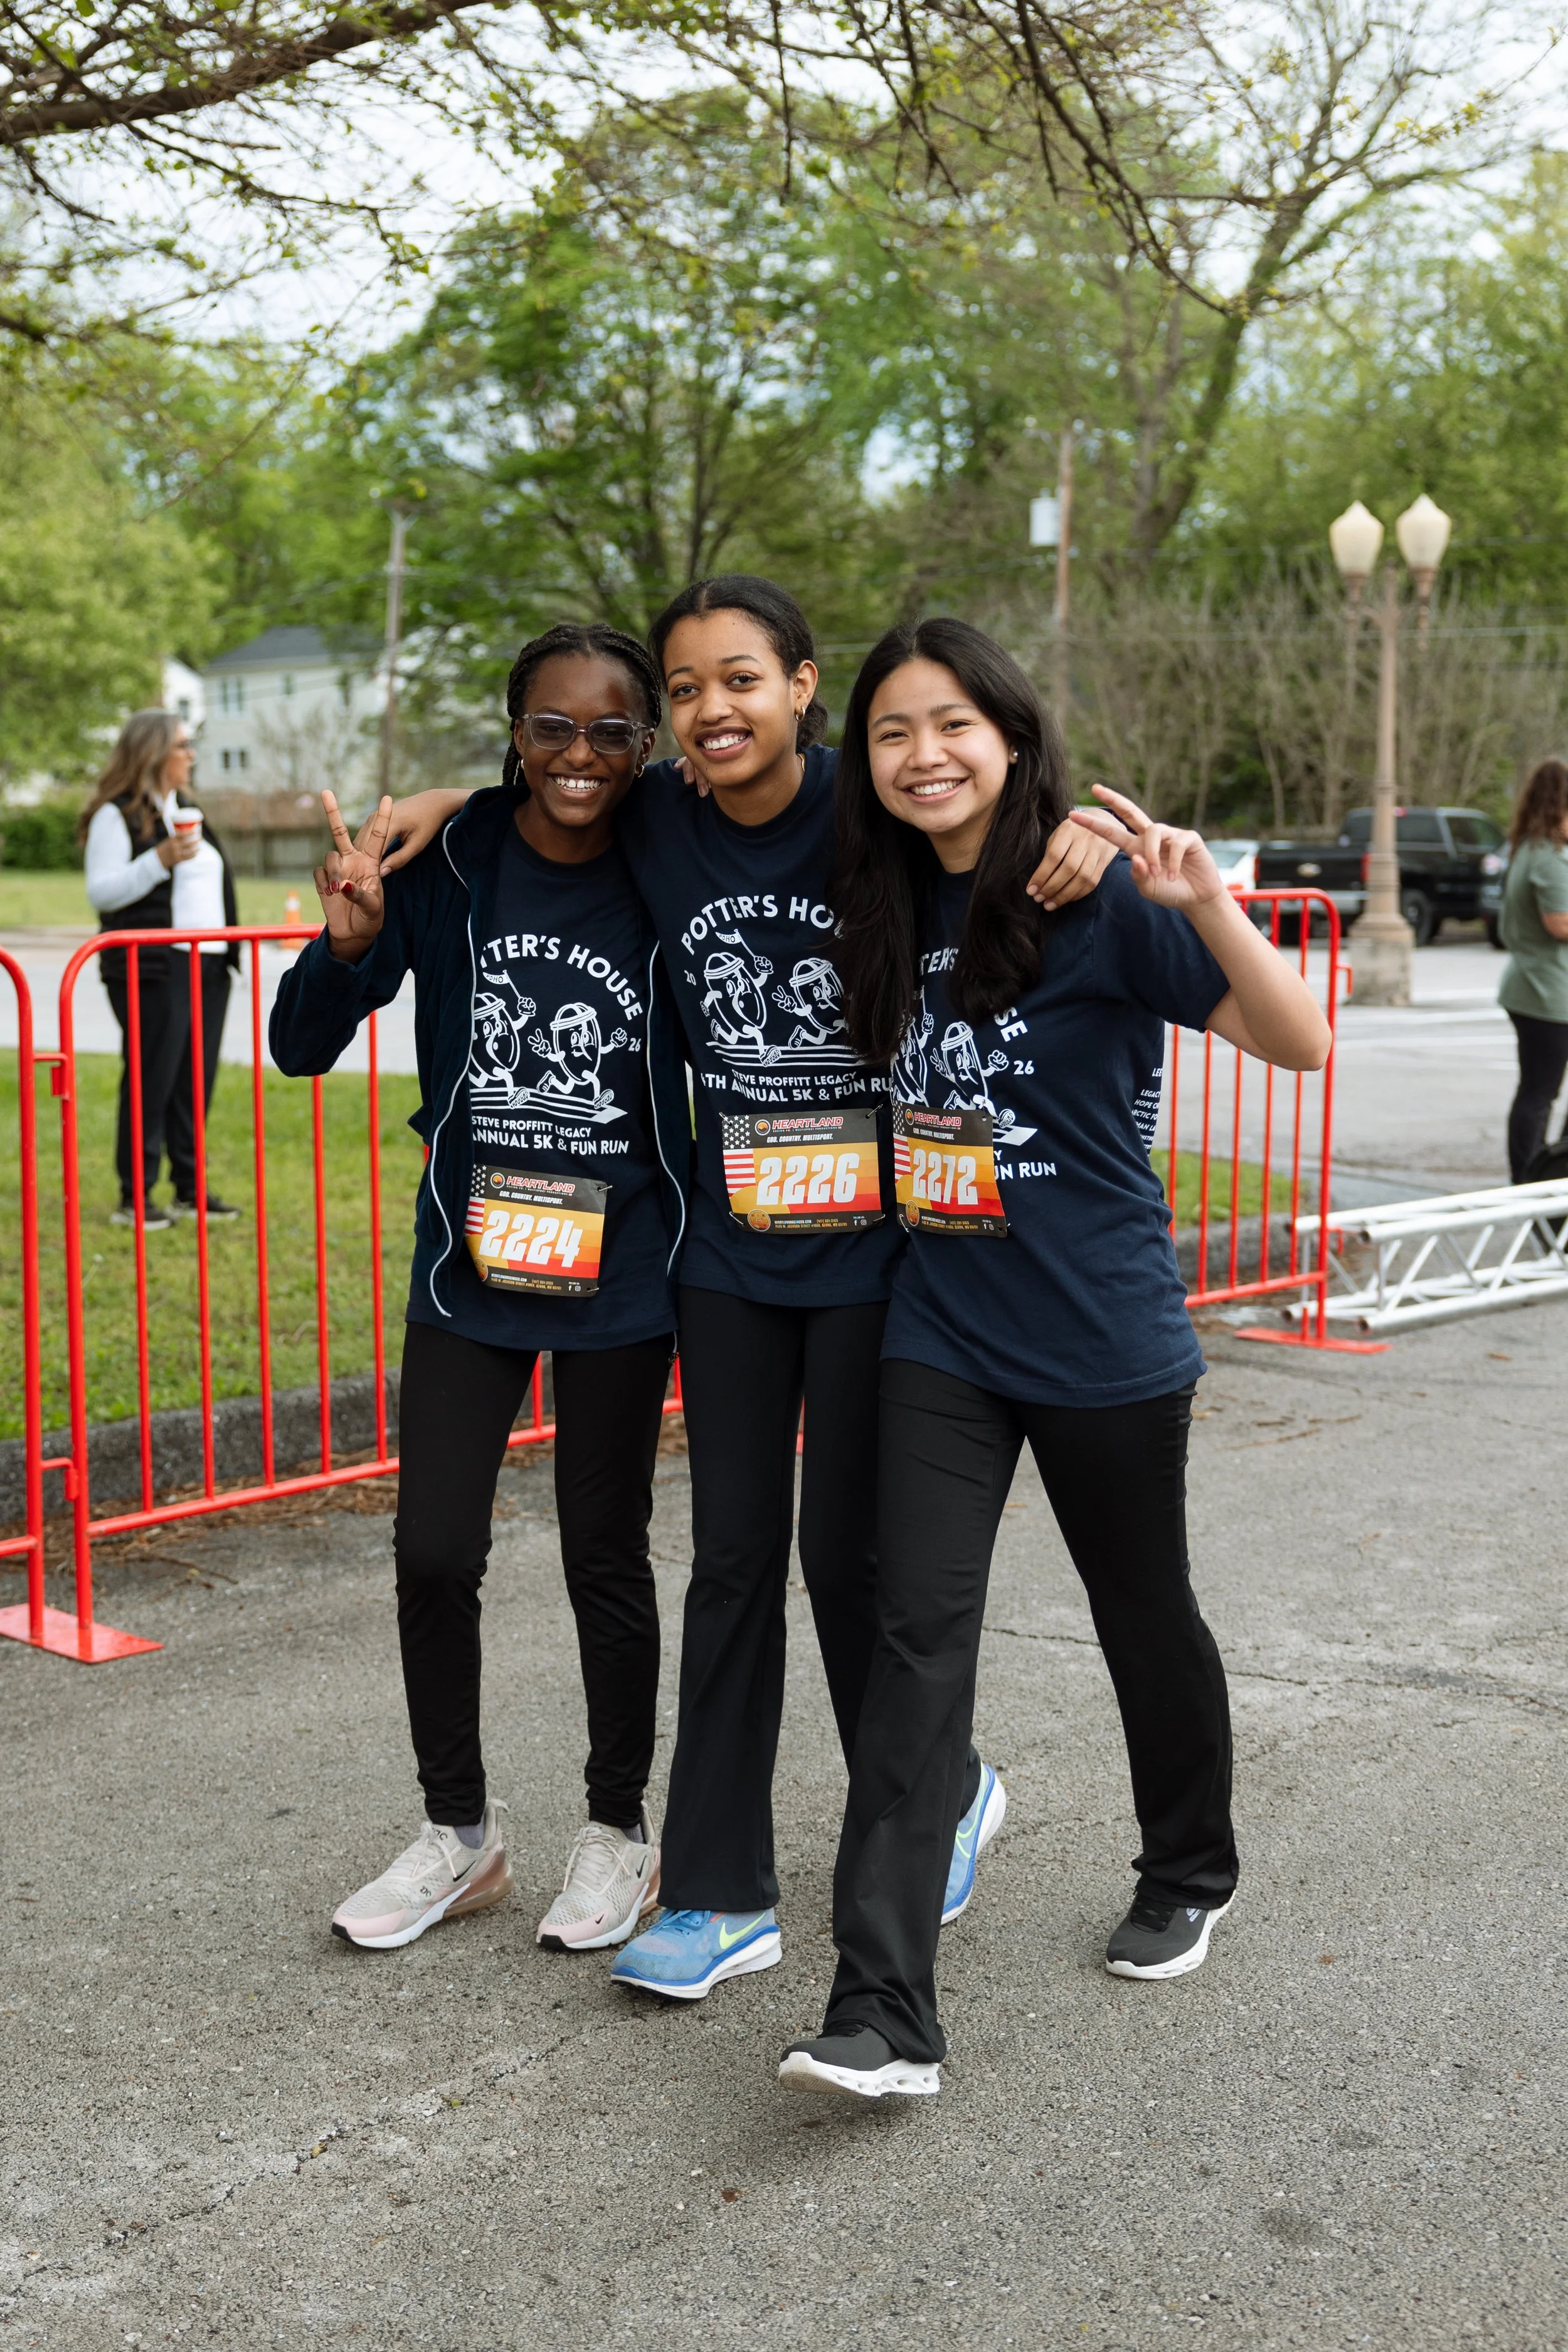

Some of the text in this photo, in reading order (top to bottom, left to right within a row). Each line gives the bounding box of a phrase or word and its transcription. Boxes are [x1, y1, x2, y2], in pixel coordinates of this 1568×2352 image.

[681, 894, 778, 956] POTTER'S
[566, 944, 643, 1021] HOUSE
[684, 970, 697, 986] 20
[628, 1037, 642, 1052] 26
[1013, 1060, 1034, 1075] 26
[731, 1069, 857, 1086] STEVE PROFFITT LEGACY
[731, 1078, 788, 1102] ANNUAL
[792, 1089, 814, 1101] 5K
[818, 1088, 830, 1100] &
[834, 1078, 866, 1099] FUN
[1134, 1099, 1153, 1109] HOPE
[472, 1116, 591, 1138] STEVE PROFFITT LEGACY
[772, 1116, 844, 1130] HEARTLAND
[914, 1111, 961, 1126] HEARTLAND
[533, 1134, 553, 1149] 5K
[557, 1138, 567, 1152] &
[570, 1140, 597, 1155] FUN
[600, 1140, 629, 1154] RUN
[756, 1153, 860, 1205] 2226
[913, 1148, 978, 1205] 2272
[1018, 1162, 1057, 1179] RUN
[506, 1175, 576, 1193] HEARTLAND
[532, 1195, 563, 1205] MULTISPORT.
[479, 1210, 583, 1268] 2224
